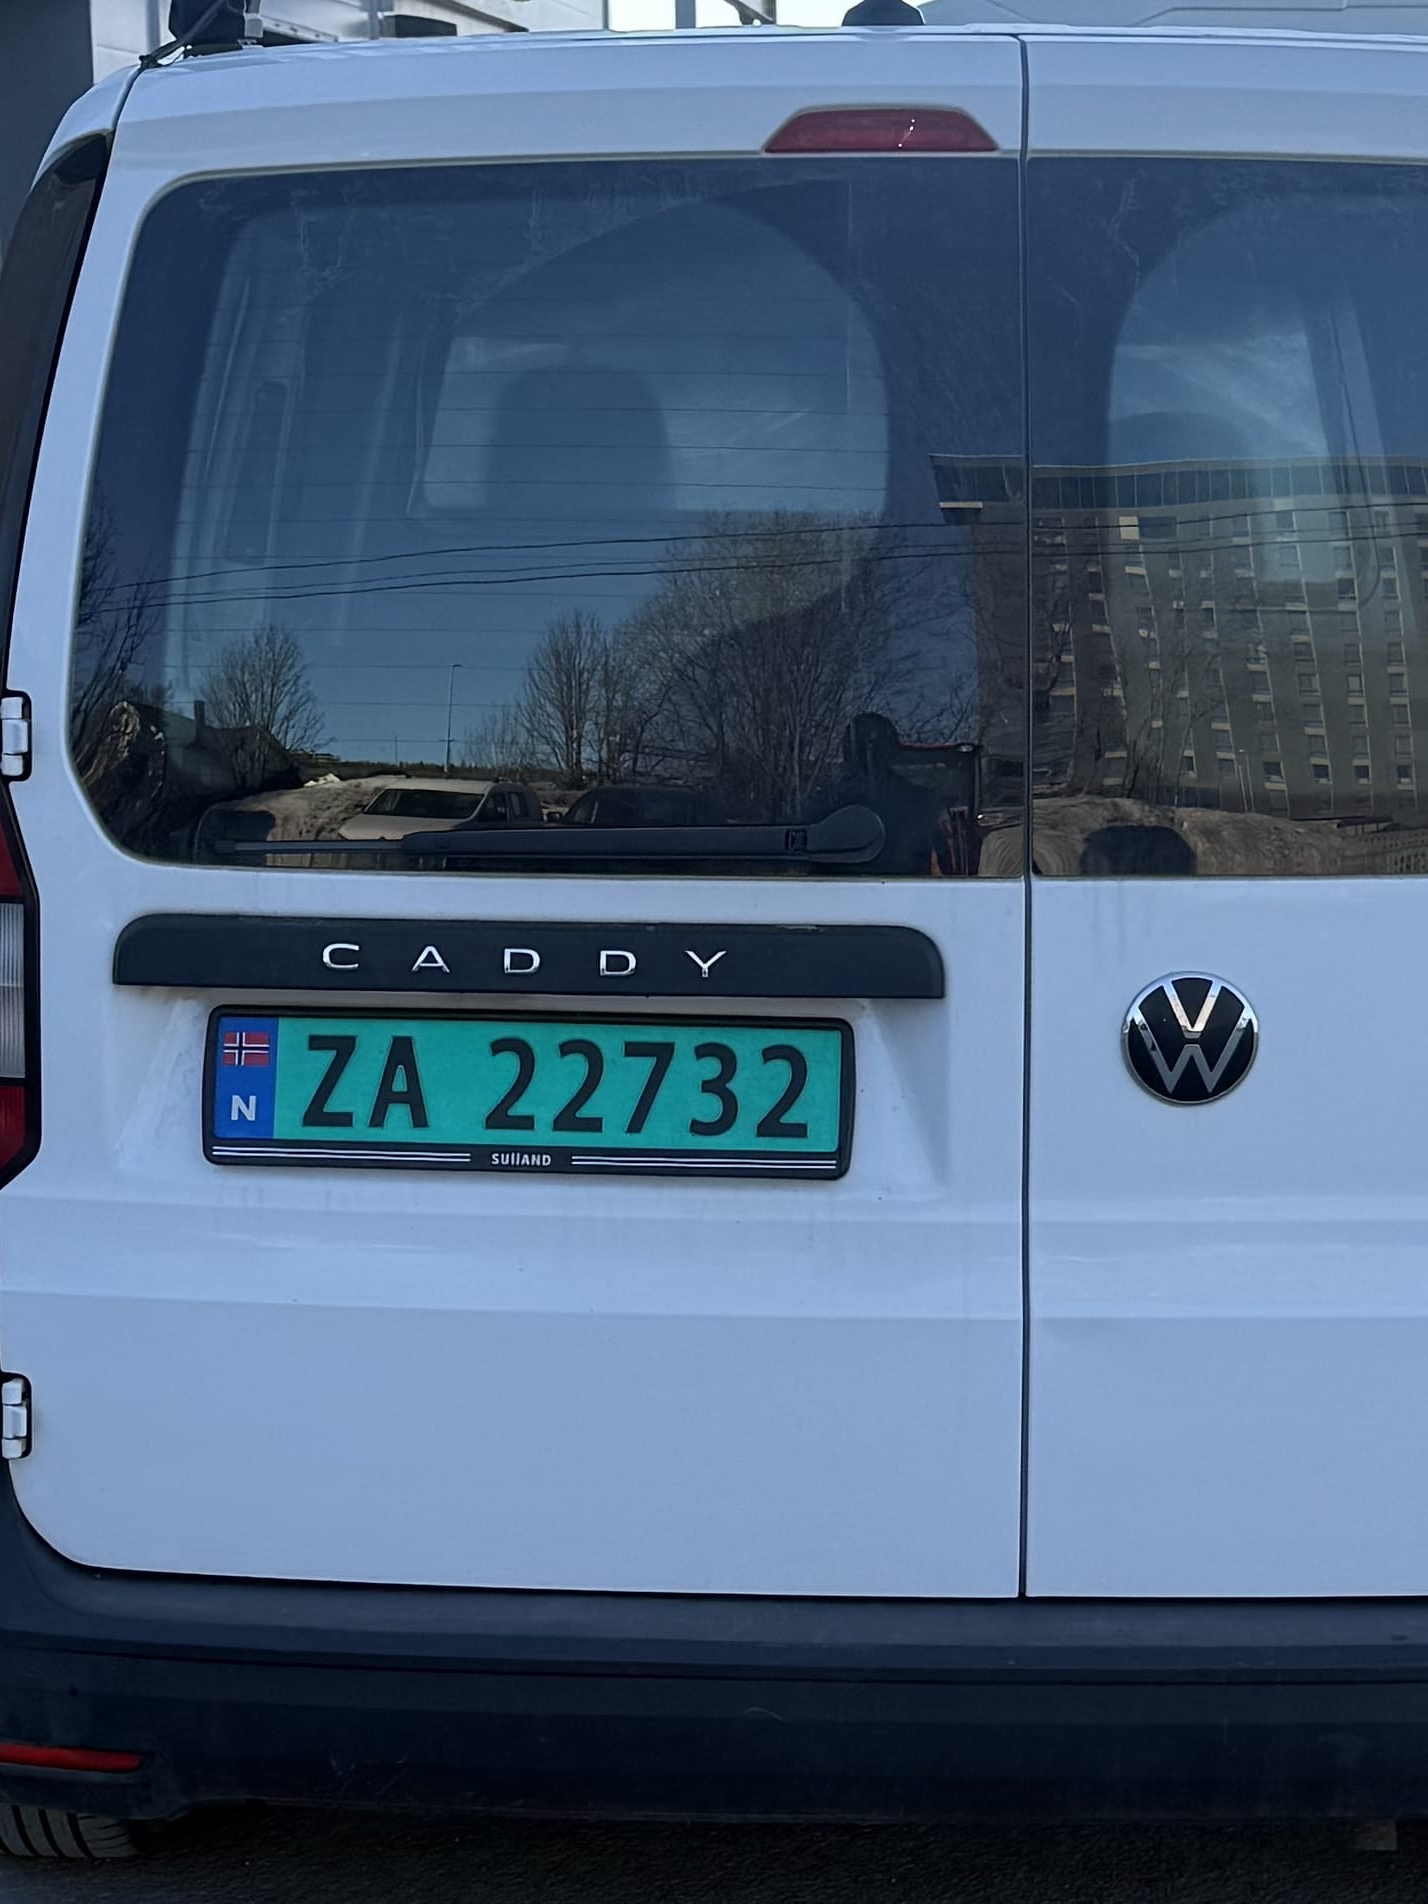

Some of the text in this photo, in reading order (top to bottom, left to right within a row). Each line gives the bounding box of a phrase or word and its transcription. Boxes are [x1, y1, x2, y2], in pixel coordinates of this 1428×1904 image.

[321, 942, 727, 978] CADDY
[301, 1034, 810, 1139] ZA 22732
[229, 1094, 257, 1122] N
